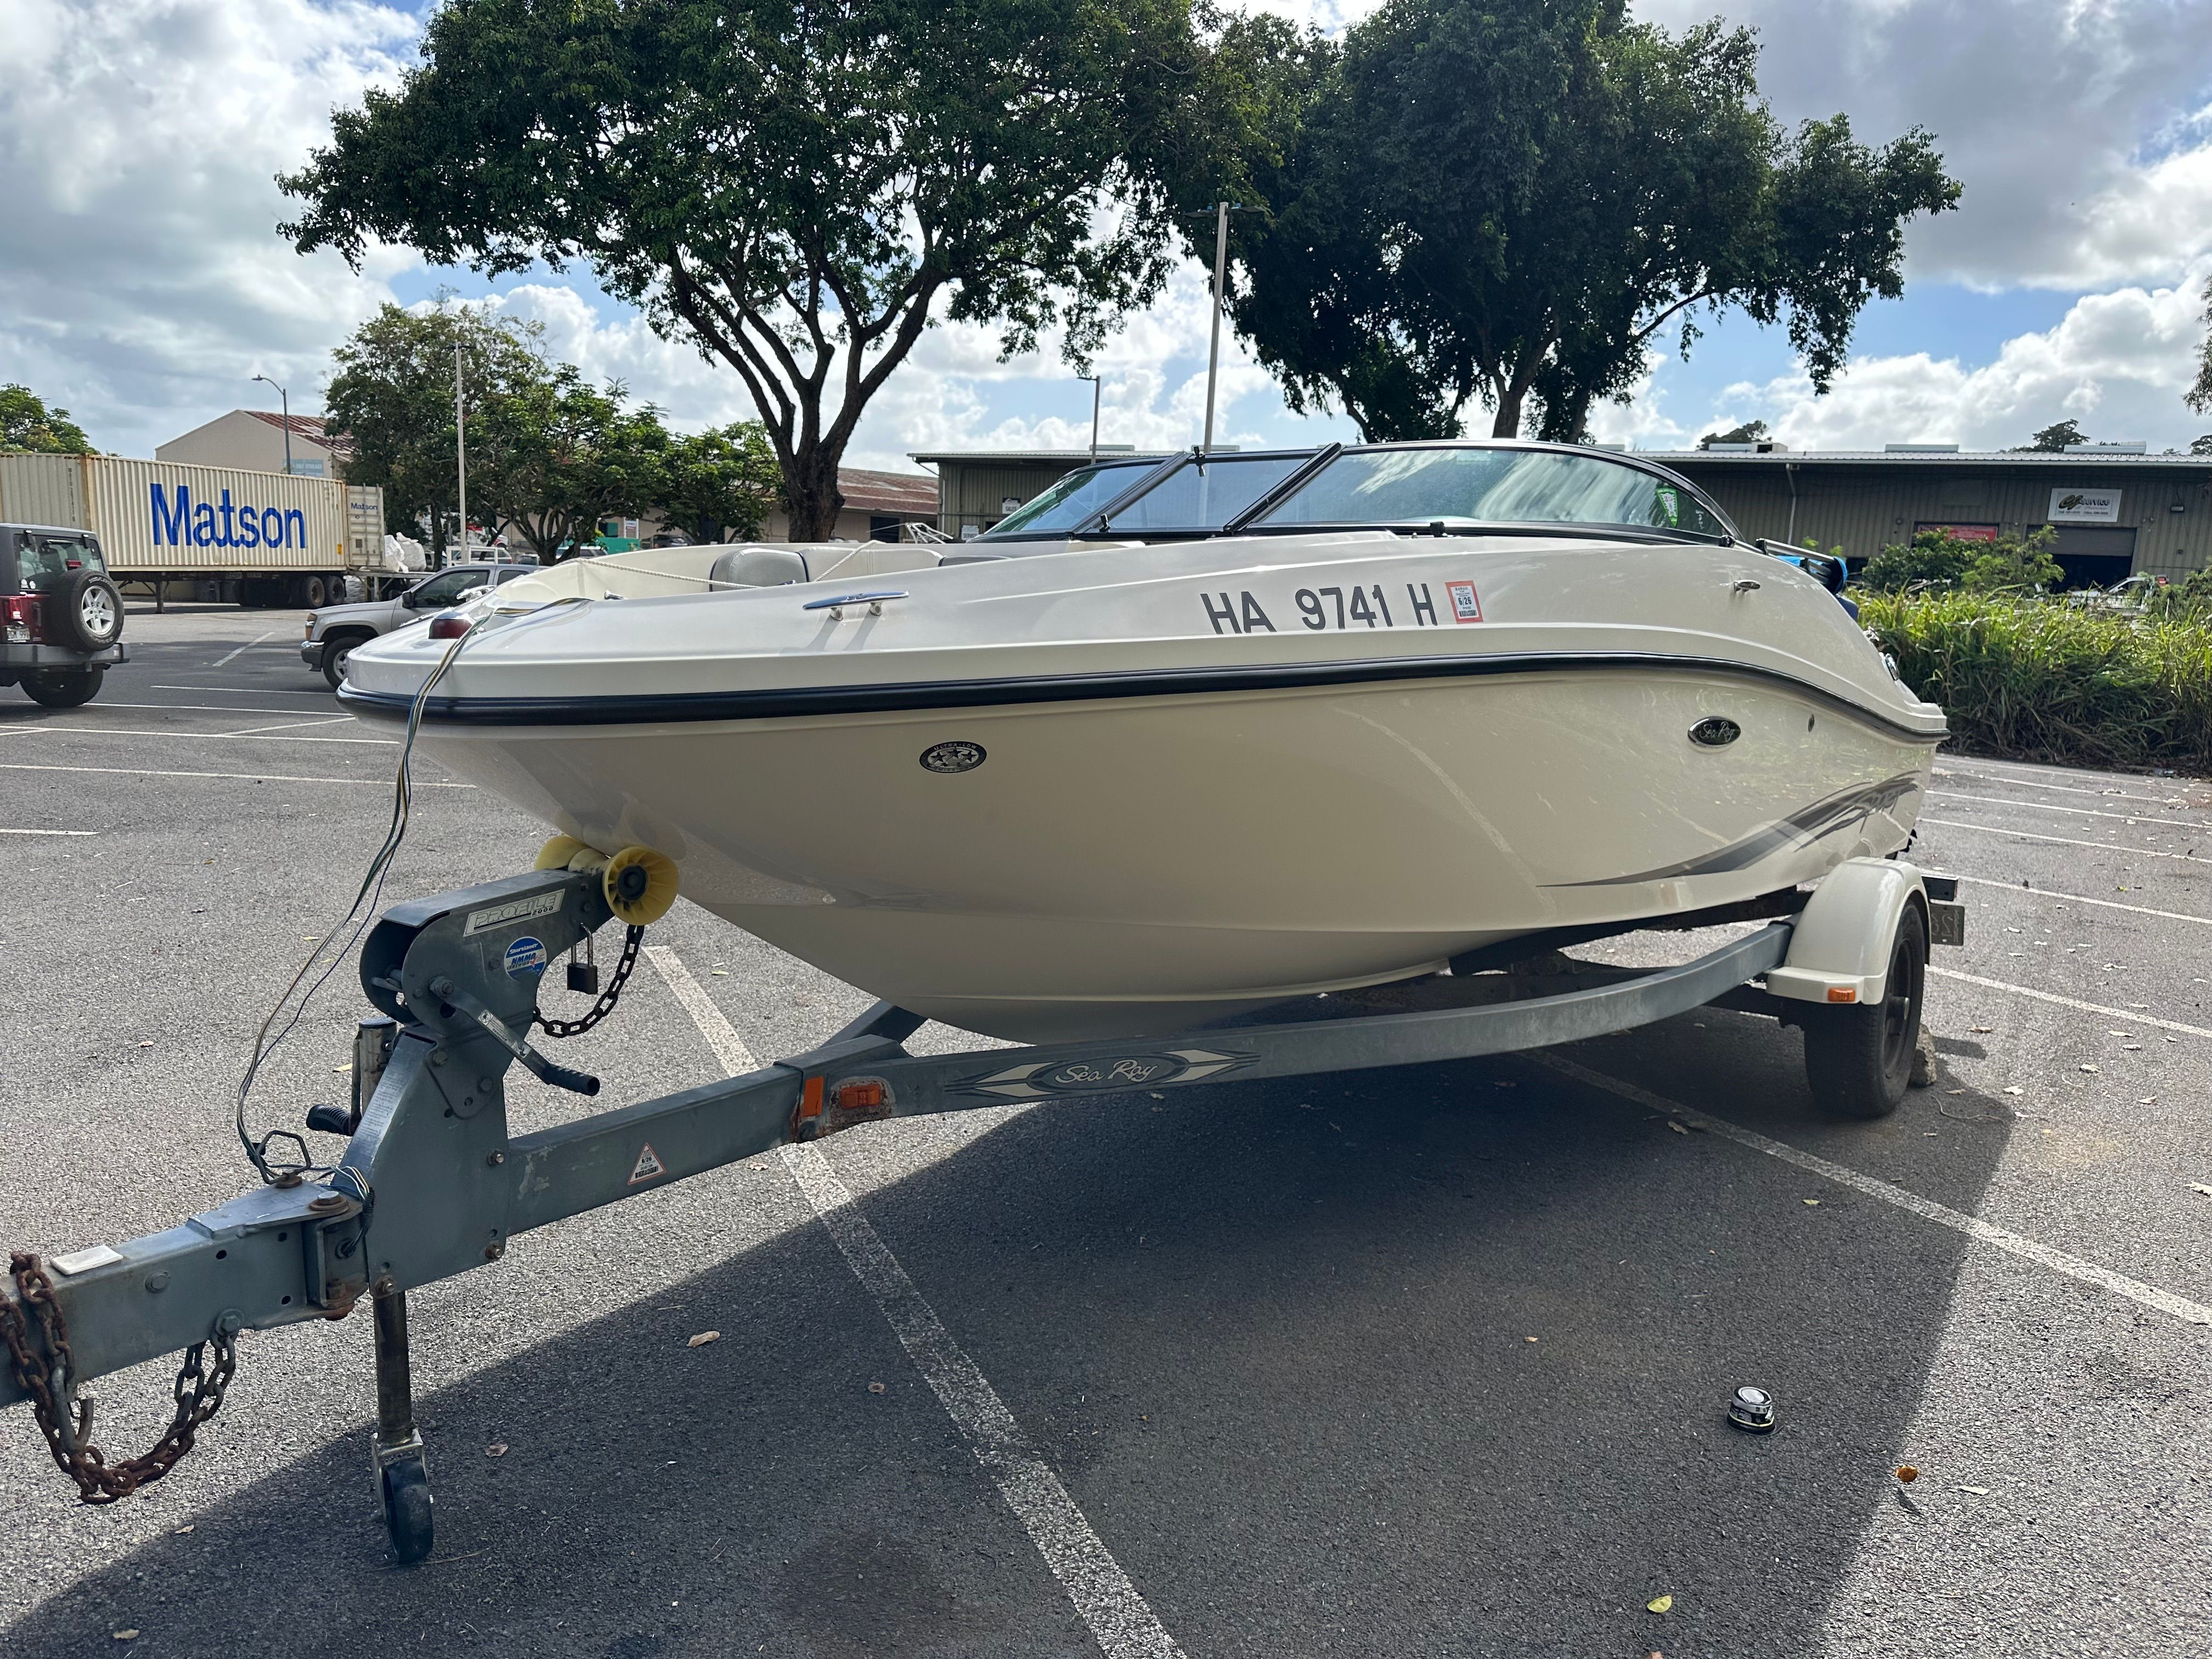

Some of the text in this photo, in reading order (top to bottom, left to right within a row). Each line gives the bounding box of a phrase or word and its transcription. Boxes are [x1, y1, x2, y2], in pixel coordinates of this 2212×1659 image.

[150, 483, 306, 549] Matson
[1200, 583, 1437, 634] HA 9741 H
[1699, 721, 1735, 742] Sea Ray
[475, 894, 557, 926] PROFILE
[532, 906, 554, 916] 2000
[1054, 1059, 1159, 1084] Sea Ray
